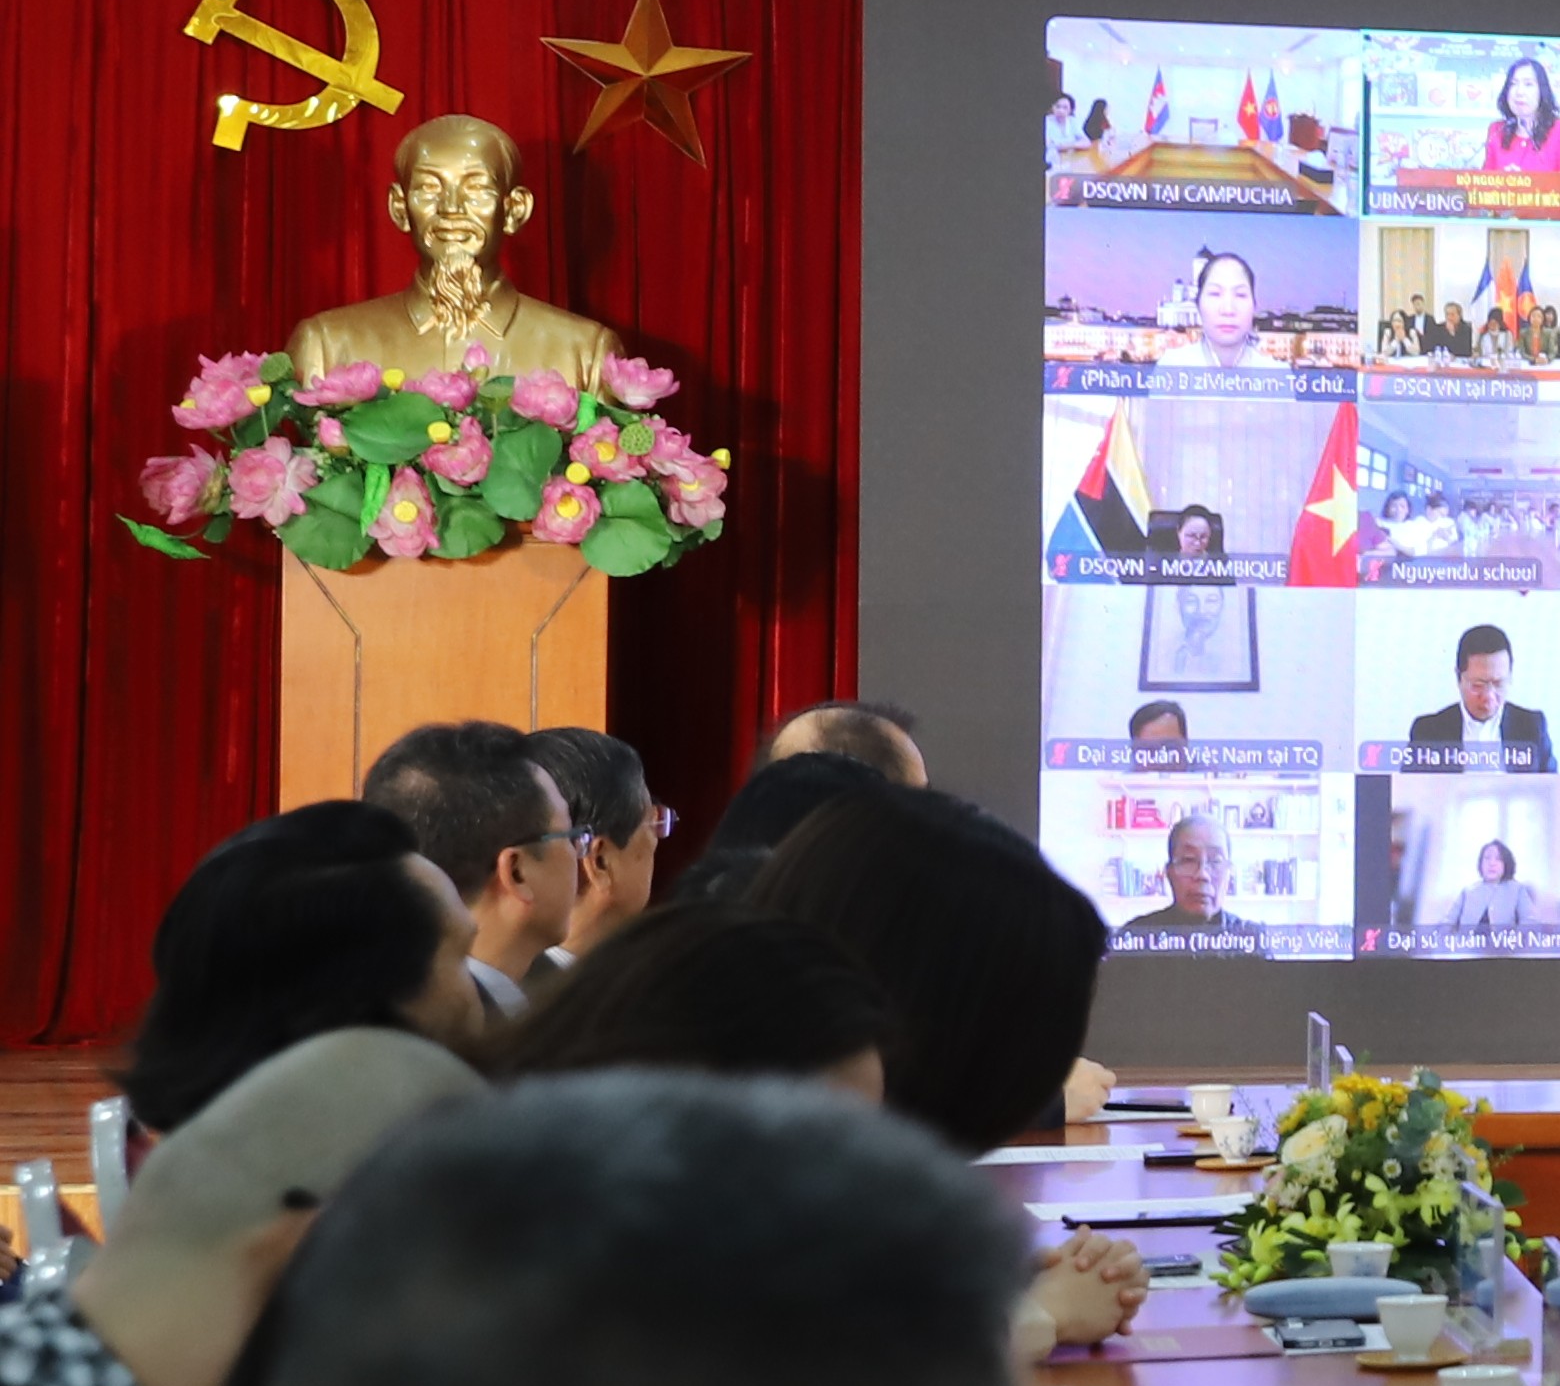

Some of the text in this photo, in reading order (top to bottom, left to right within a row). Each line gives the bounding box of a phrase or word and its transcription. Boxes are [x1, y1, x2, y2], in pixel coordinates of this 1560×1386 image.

[1184, 184, 1294, 205] CAMPUCHIA
[1369, 192, 1466, 213] UBNV-BNG
[1161, 559, 1288, 580] MOZAMBIQUE
[1391, 562, 1478, 585] Nguyendu
[1184, 746, 1219, 766] Việt
[1223, 747, 1263, 765] Nam
[1267, 746, 1289, 768] tại
[1293, 747, 1319, 766] TQ
[1113, 930, 1145, 951] uân
[1149, 930, 1186, 951] Lâm
